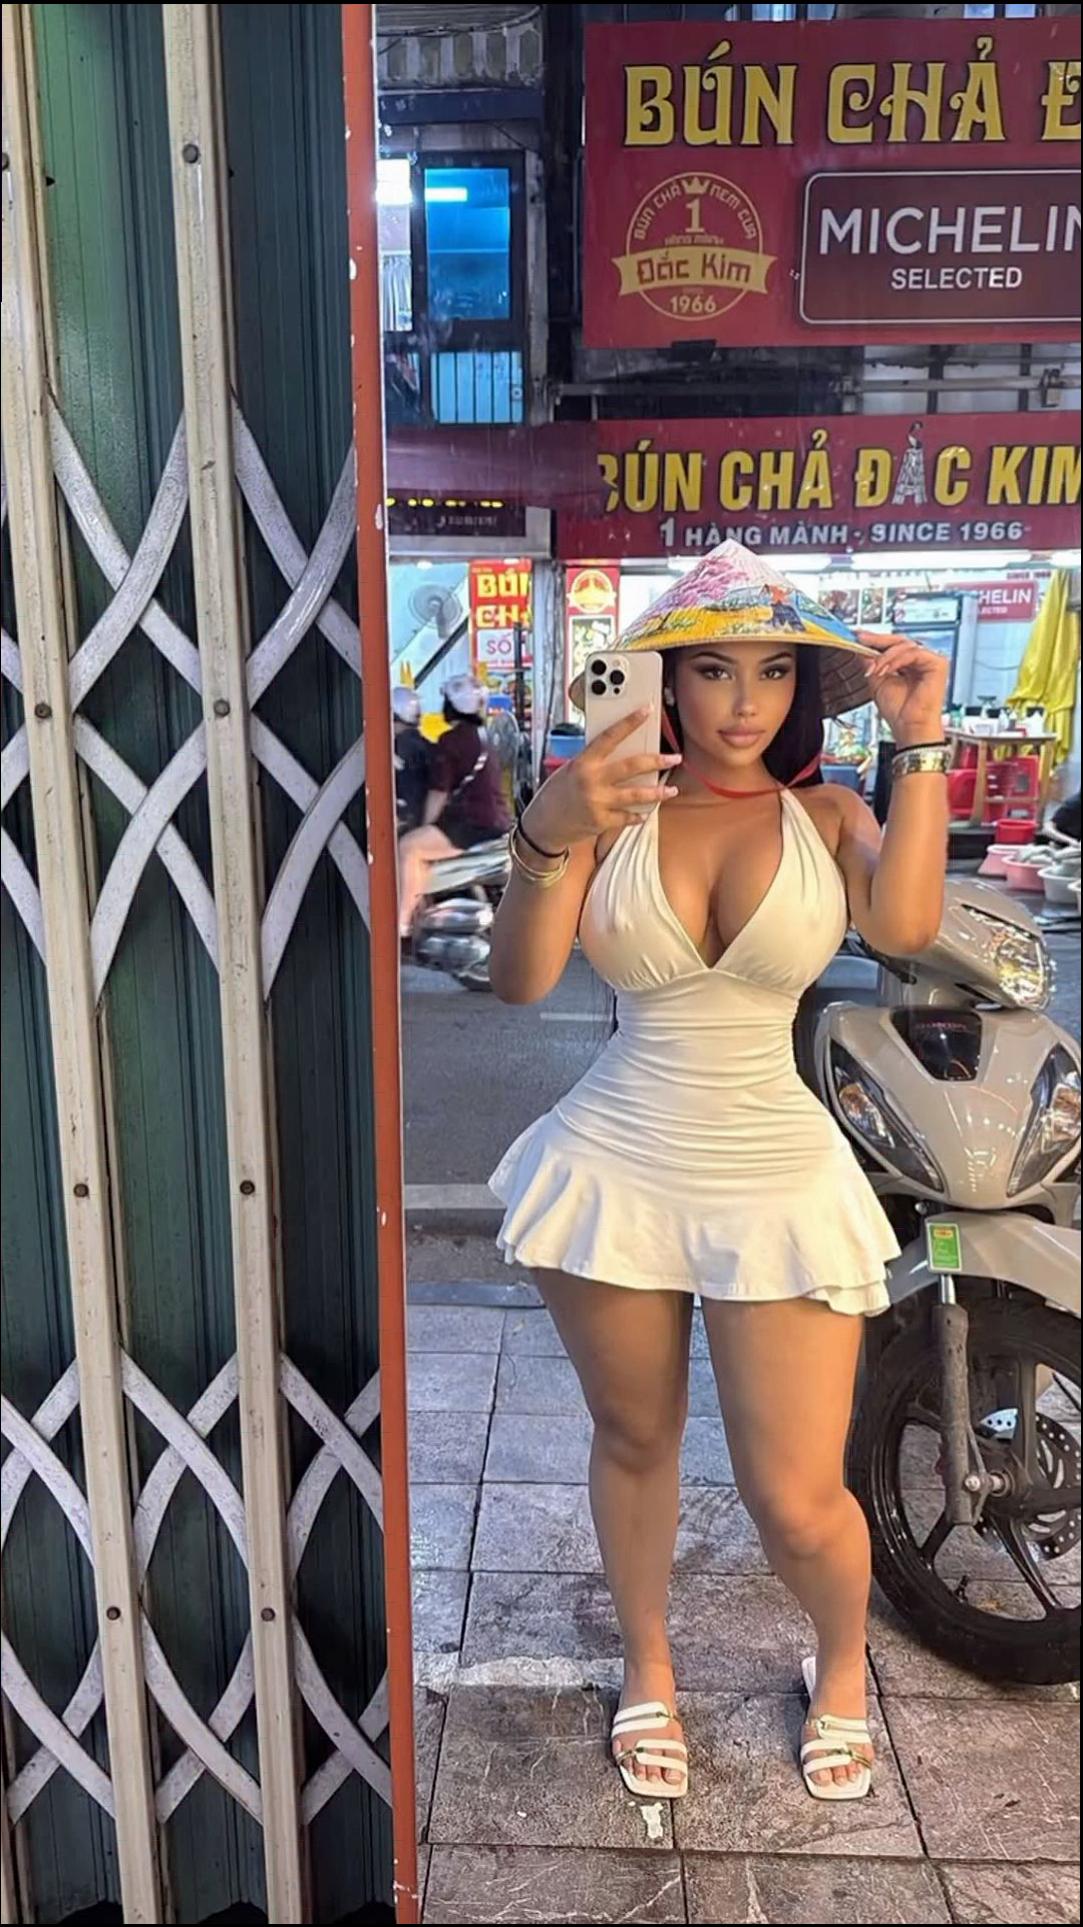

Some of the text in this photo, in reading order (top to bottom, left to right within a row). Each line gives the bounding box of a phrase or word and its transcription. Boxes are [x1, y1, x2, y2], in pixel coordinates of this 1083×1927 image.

[624, 39, 798, 146] BÚN
[827, 36, 1006, 143] CHẢ
[685, 199, 705, 233] 1
[819, 206, 1081, 255] MICHELIN
[701, 252, 751, 283] Kim
[891, 267, 1022, 290] SELECTED
[670, 295, 717, 313] 1966
[719, 429, 833, 511] CHẢ
[660, 517, 675, 547] 1
[871, 523, 950, 543] SINCE
[960, 521, 1023, 541] 1966
[979, 588, 1032, 605] HELIN
